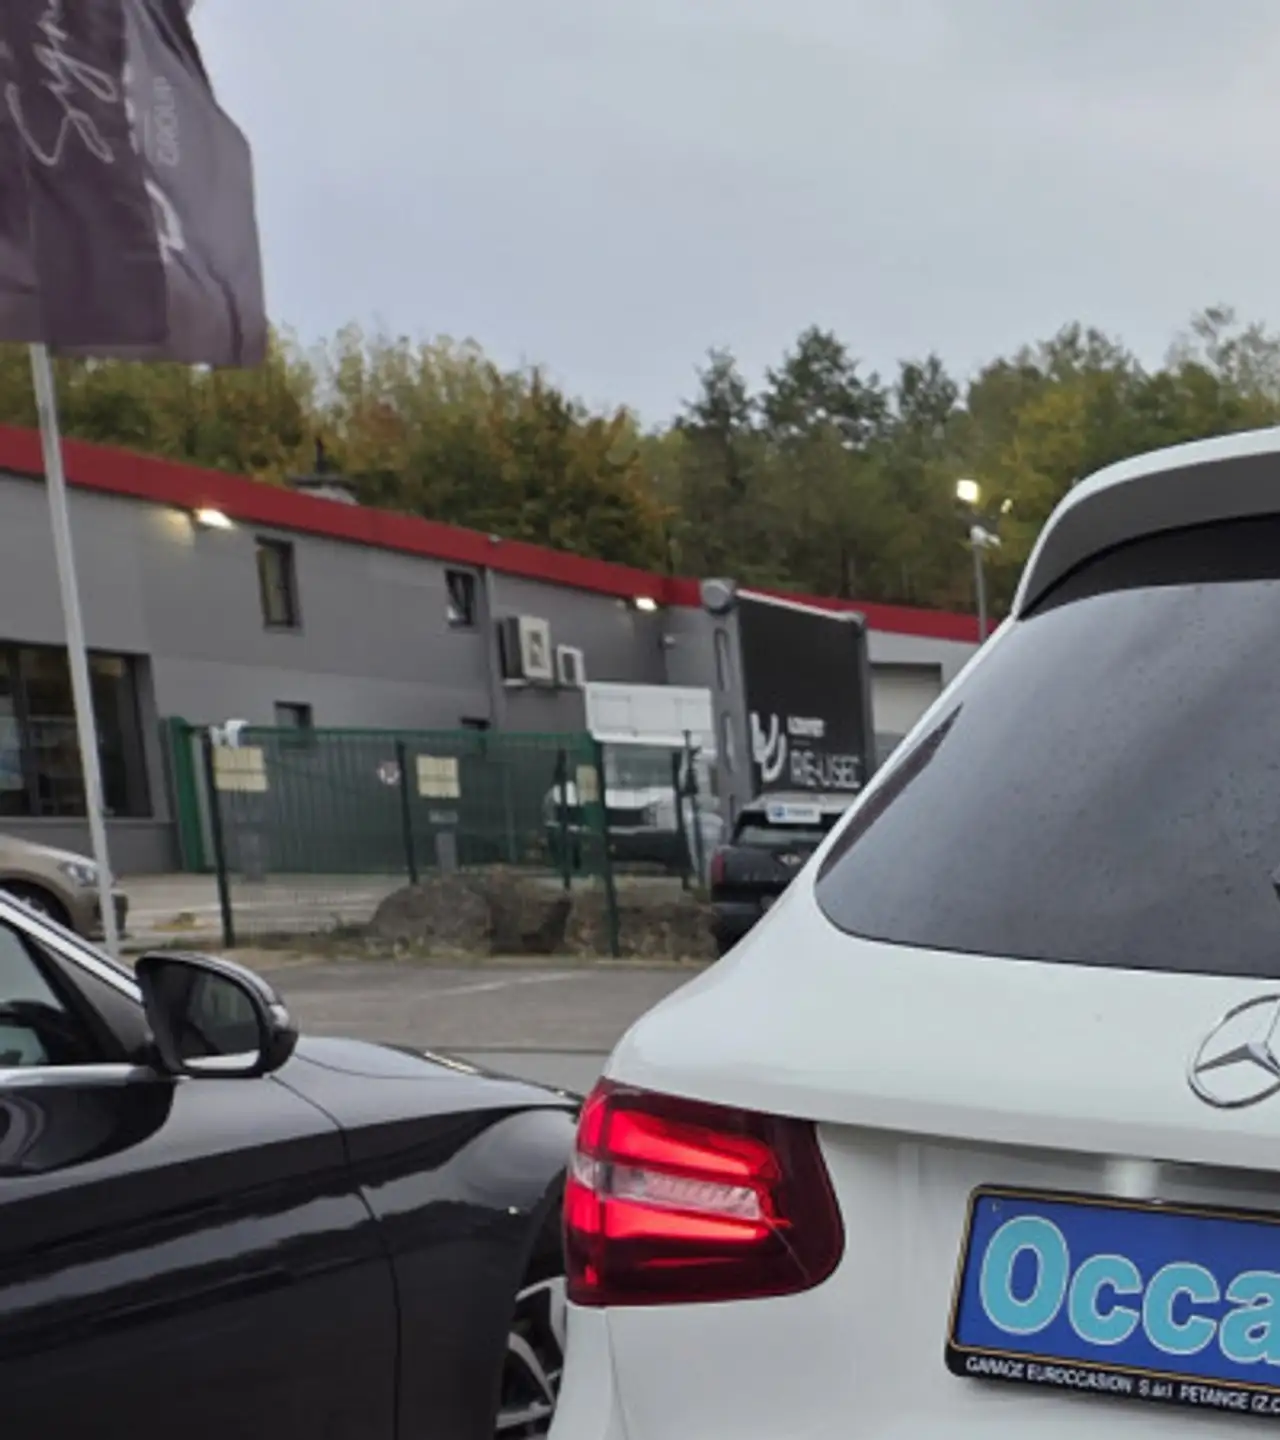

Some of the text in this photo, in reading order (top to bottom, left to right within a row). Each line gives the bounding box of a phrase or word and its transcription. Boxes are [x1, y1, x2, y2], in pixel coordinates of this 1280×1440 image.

[965, 1356, 1024, 1379] GARAGE
[1026, 1363, 1133, 1394] EUROCCASION
[1180, 1383, 1249, 1411] PETANGE
